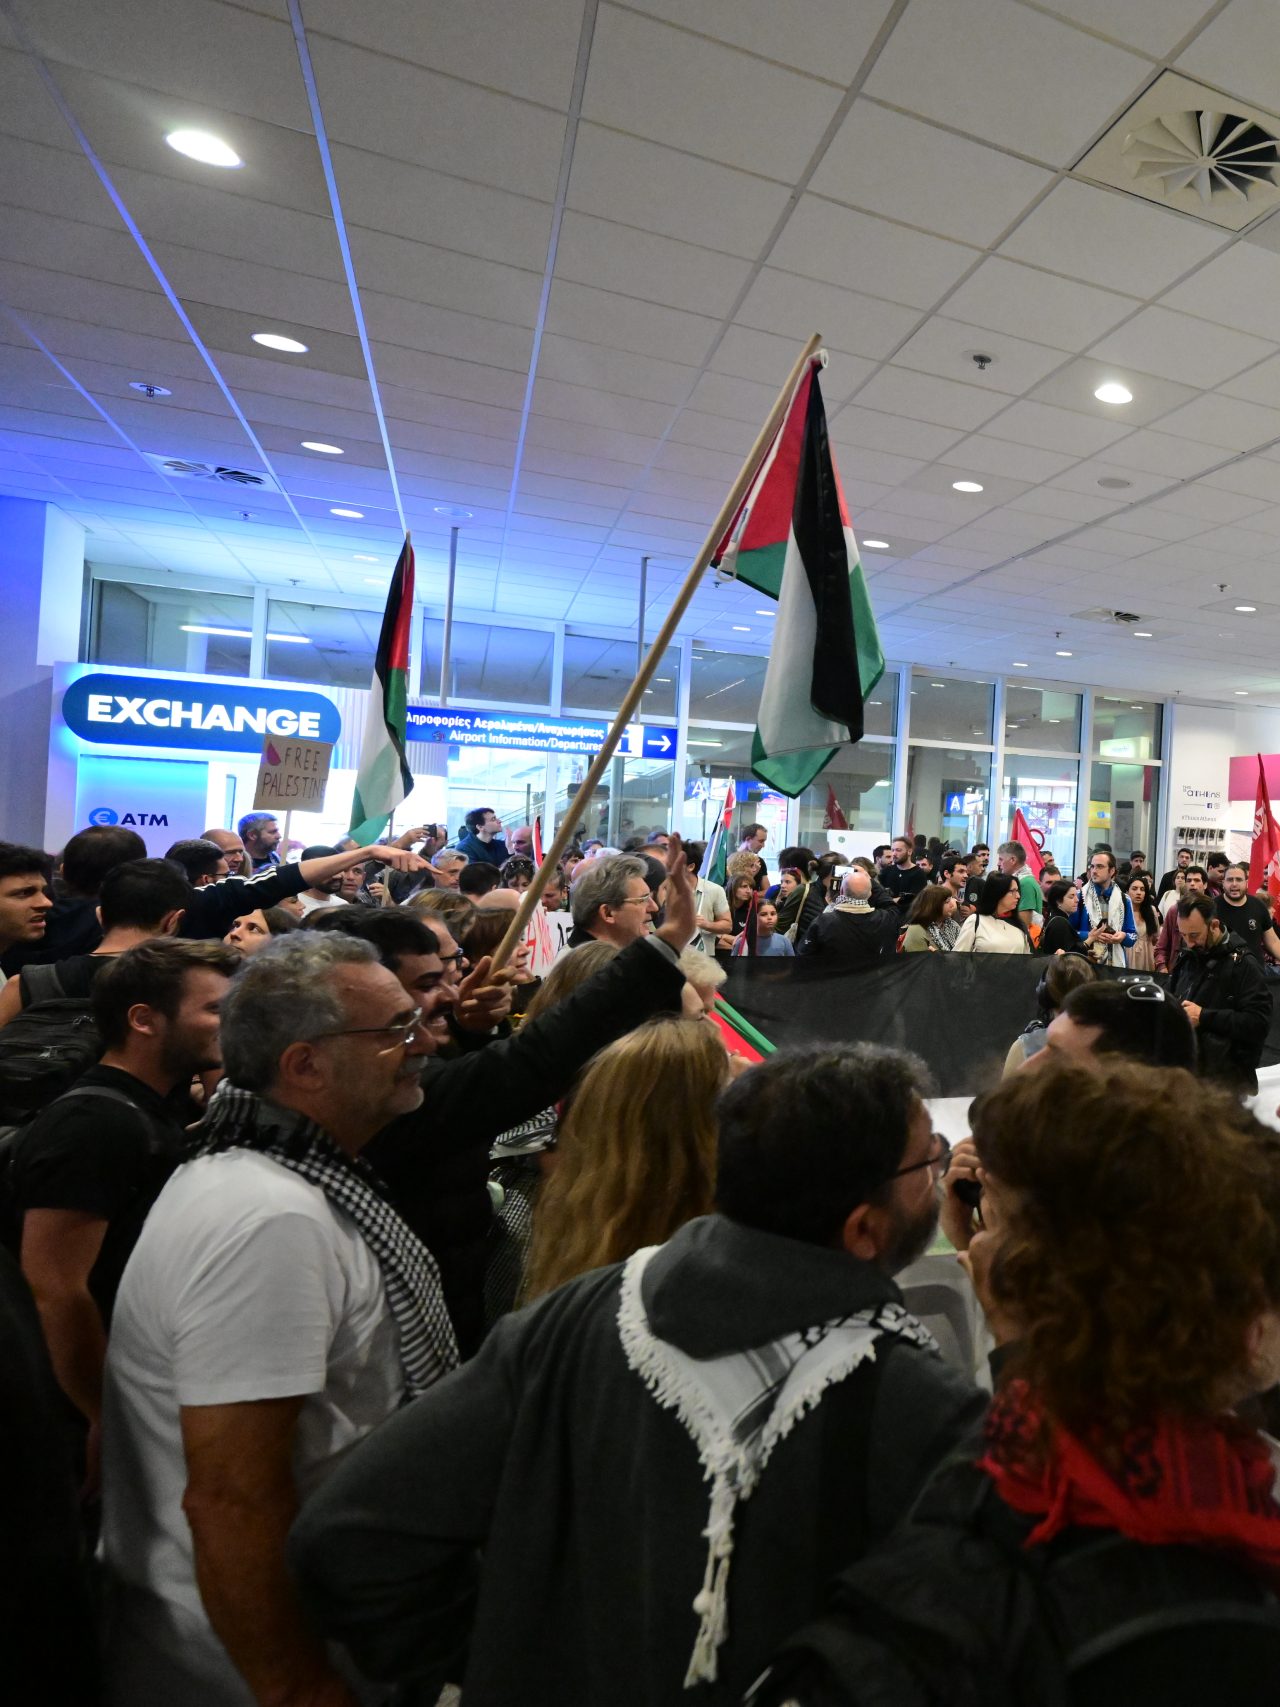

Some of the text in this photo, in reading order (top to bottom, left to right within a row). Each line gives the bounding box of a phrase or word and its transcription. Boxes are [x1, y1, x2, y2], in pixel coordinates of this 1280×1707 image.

[87, 694, 321, 738] EXCHANGE
[406, 711, 471, 729] ληροφορίες
[450, 729, 604, 752] Airport Information/Departures
[284, 747, 321, 772] FREE
[261, 772, 328, 799] PALESTINE
[121, 812, 168, 827] ATM
